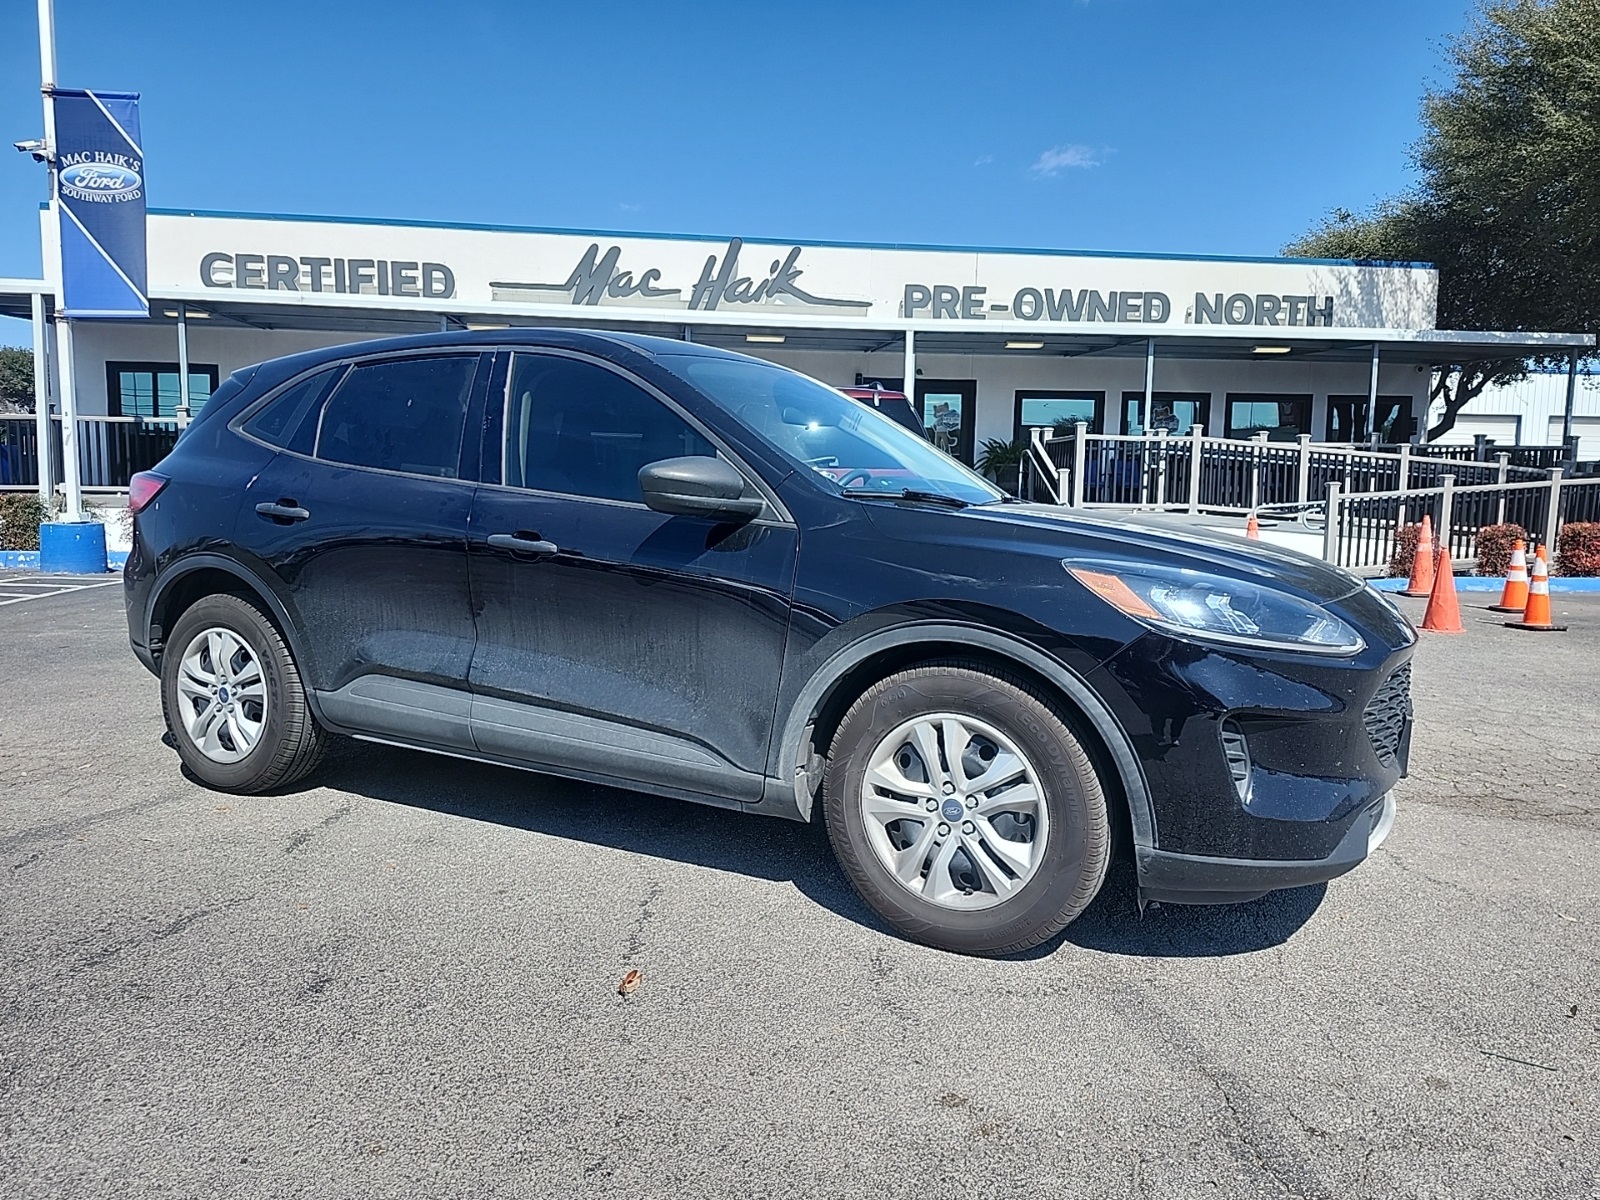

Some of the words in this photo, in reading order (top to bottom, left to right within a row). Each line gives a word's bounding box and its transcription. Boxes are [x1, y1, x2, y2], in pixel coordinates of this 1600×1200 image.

[60, 151, 91, 168] MAC
[94, 151, 141, 171] HAIK'S
[61, 186, 113, 203] SOUTHWAY
[115, 189, 141, 202] FORD
[75, 168, 125, 189] Ford
[200, 252, 455, 299] CERTIFIED
[489, 243, 681, 306] Mac
[688, 237, 872, 310] Haik
[904, 284, 1171, 323] PRE-OWNED
[1197, 292, 1333, 327] NORTH
